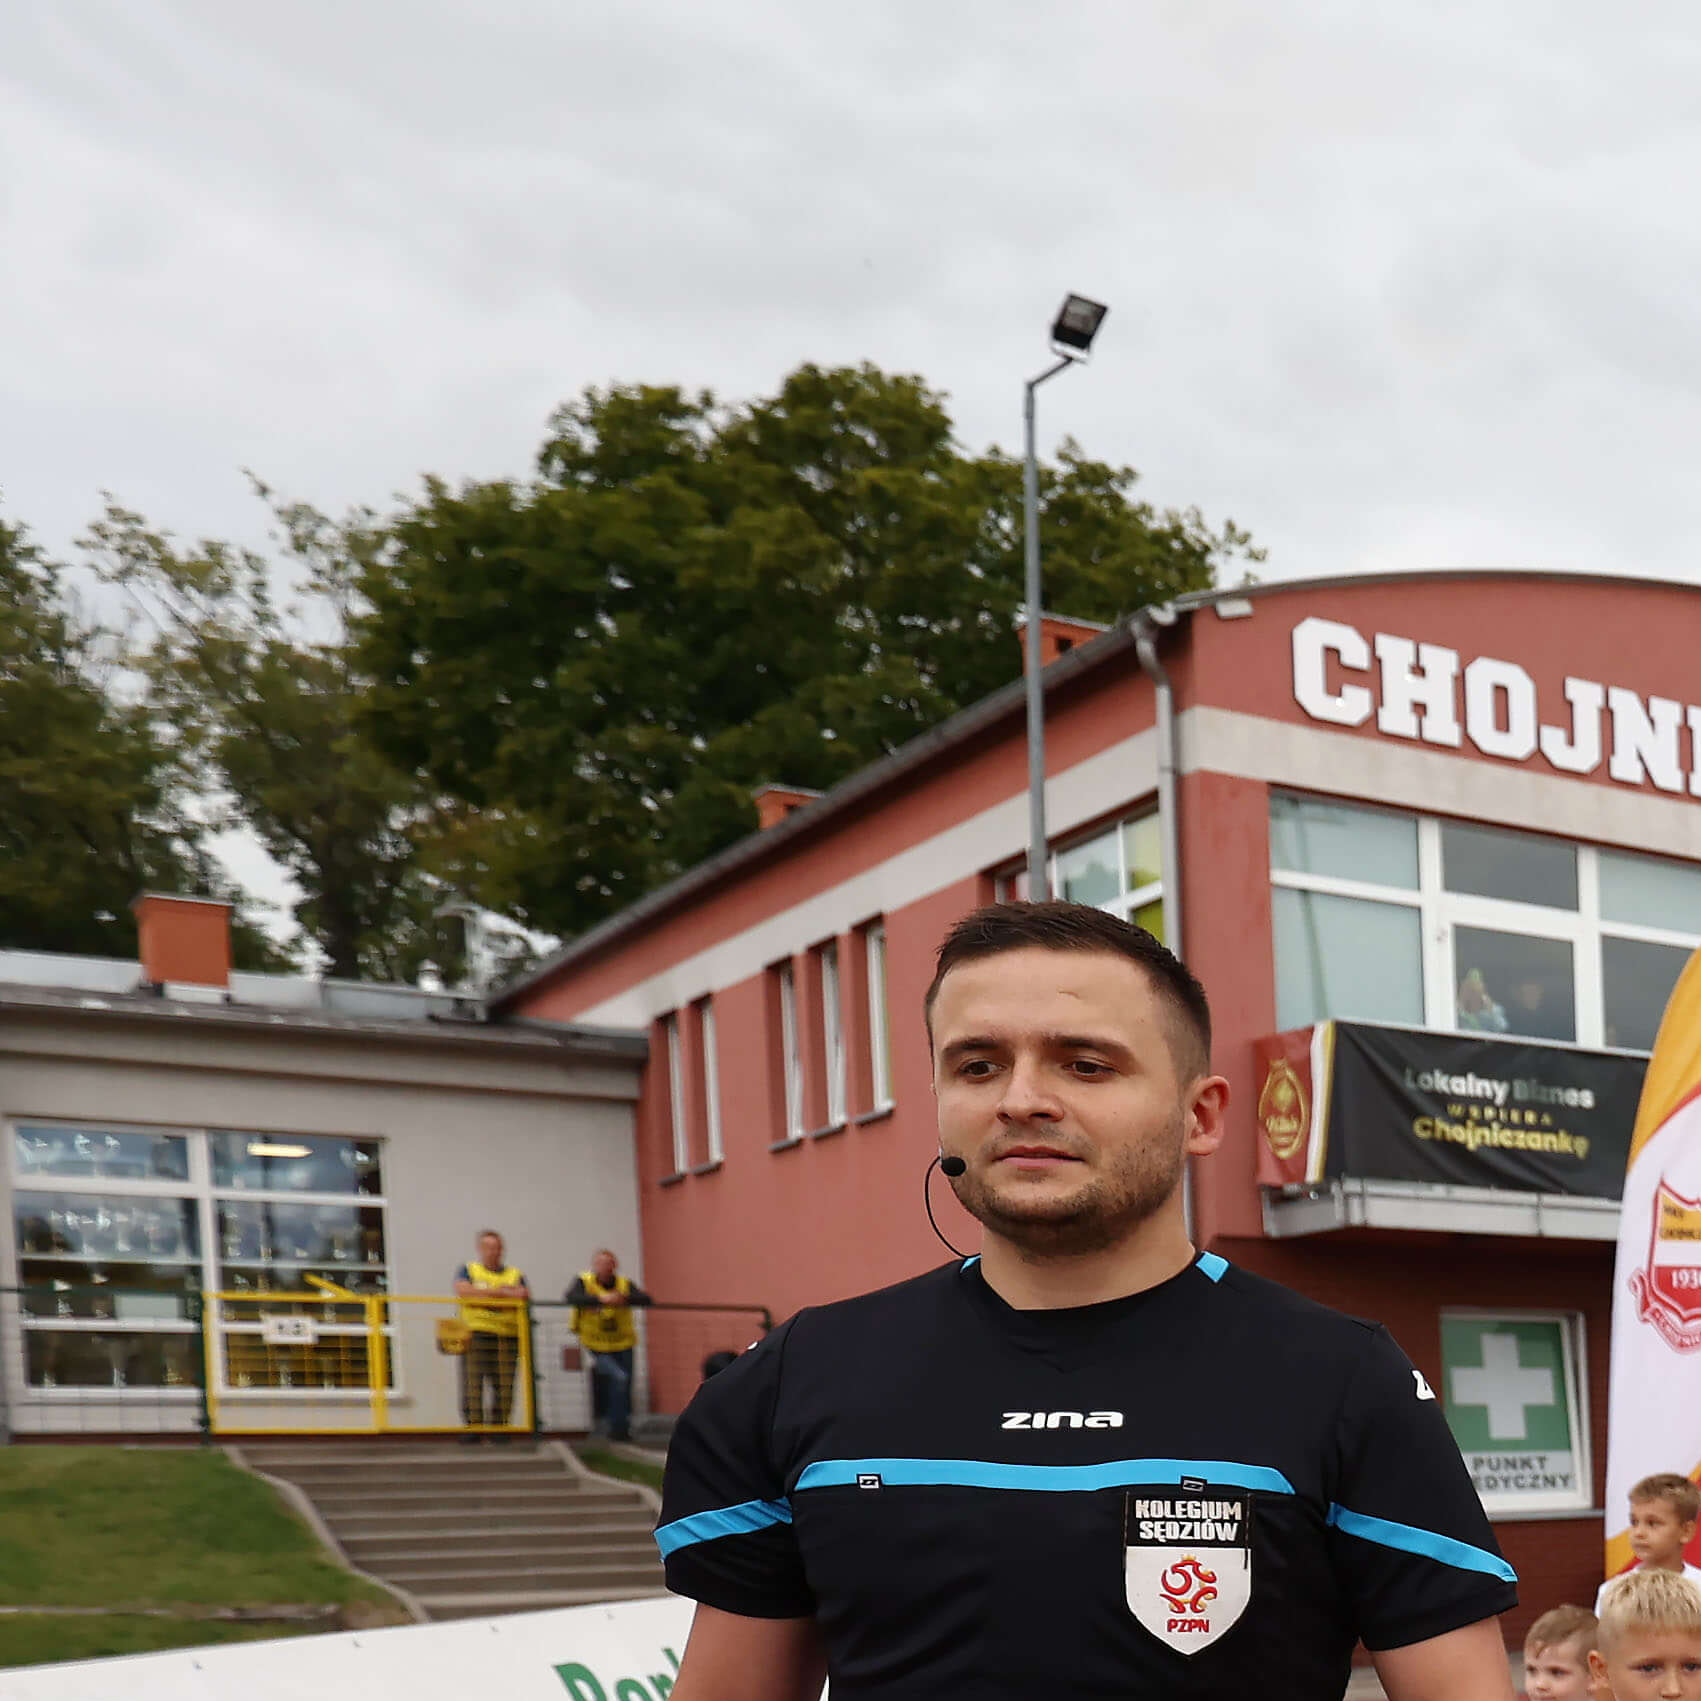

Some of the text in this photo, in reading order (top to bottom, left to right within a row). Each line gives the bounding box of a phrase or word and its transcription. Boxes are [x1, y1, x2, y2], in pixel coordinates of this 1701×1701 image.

[1001, 1410, 1124, 1429] zina
[1473, 1455, 1548, 1471] PUNKT
[1474, 1472, 1572, 1490] EDYCZNY
[1135, 1499, 1242, 1521] KOLEGIUM
[1139, 1519, 1239, 1543] SĘDZIÓW
[1167, 1618, 1210, 1633] PZPN
